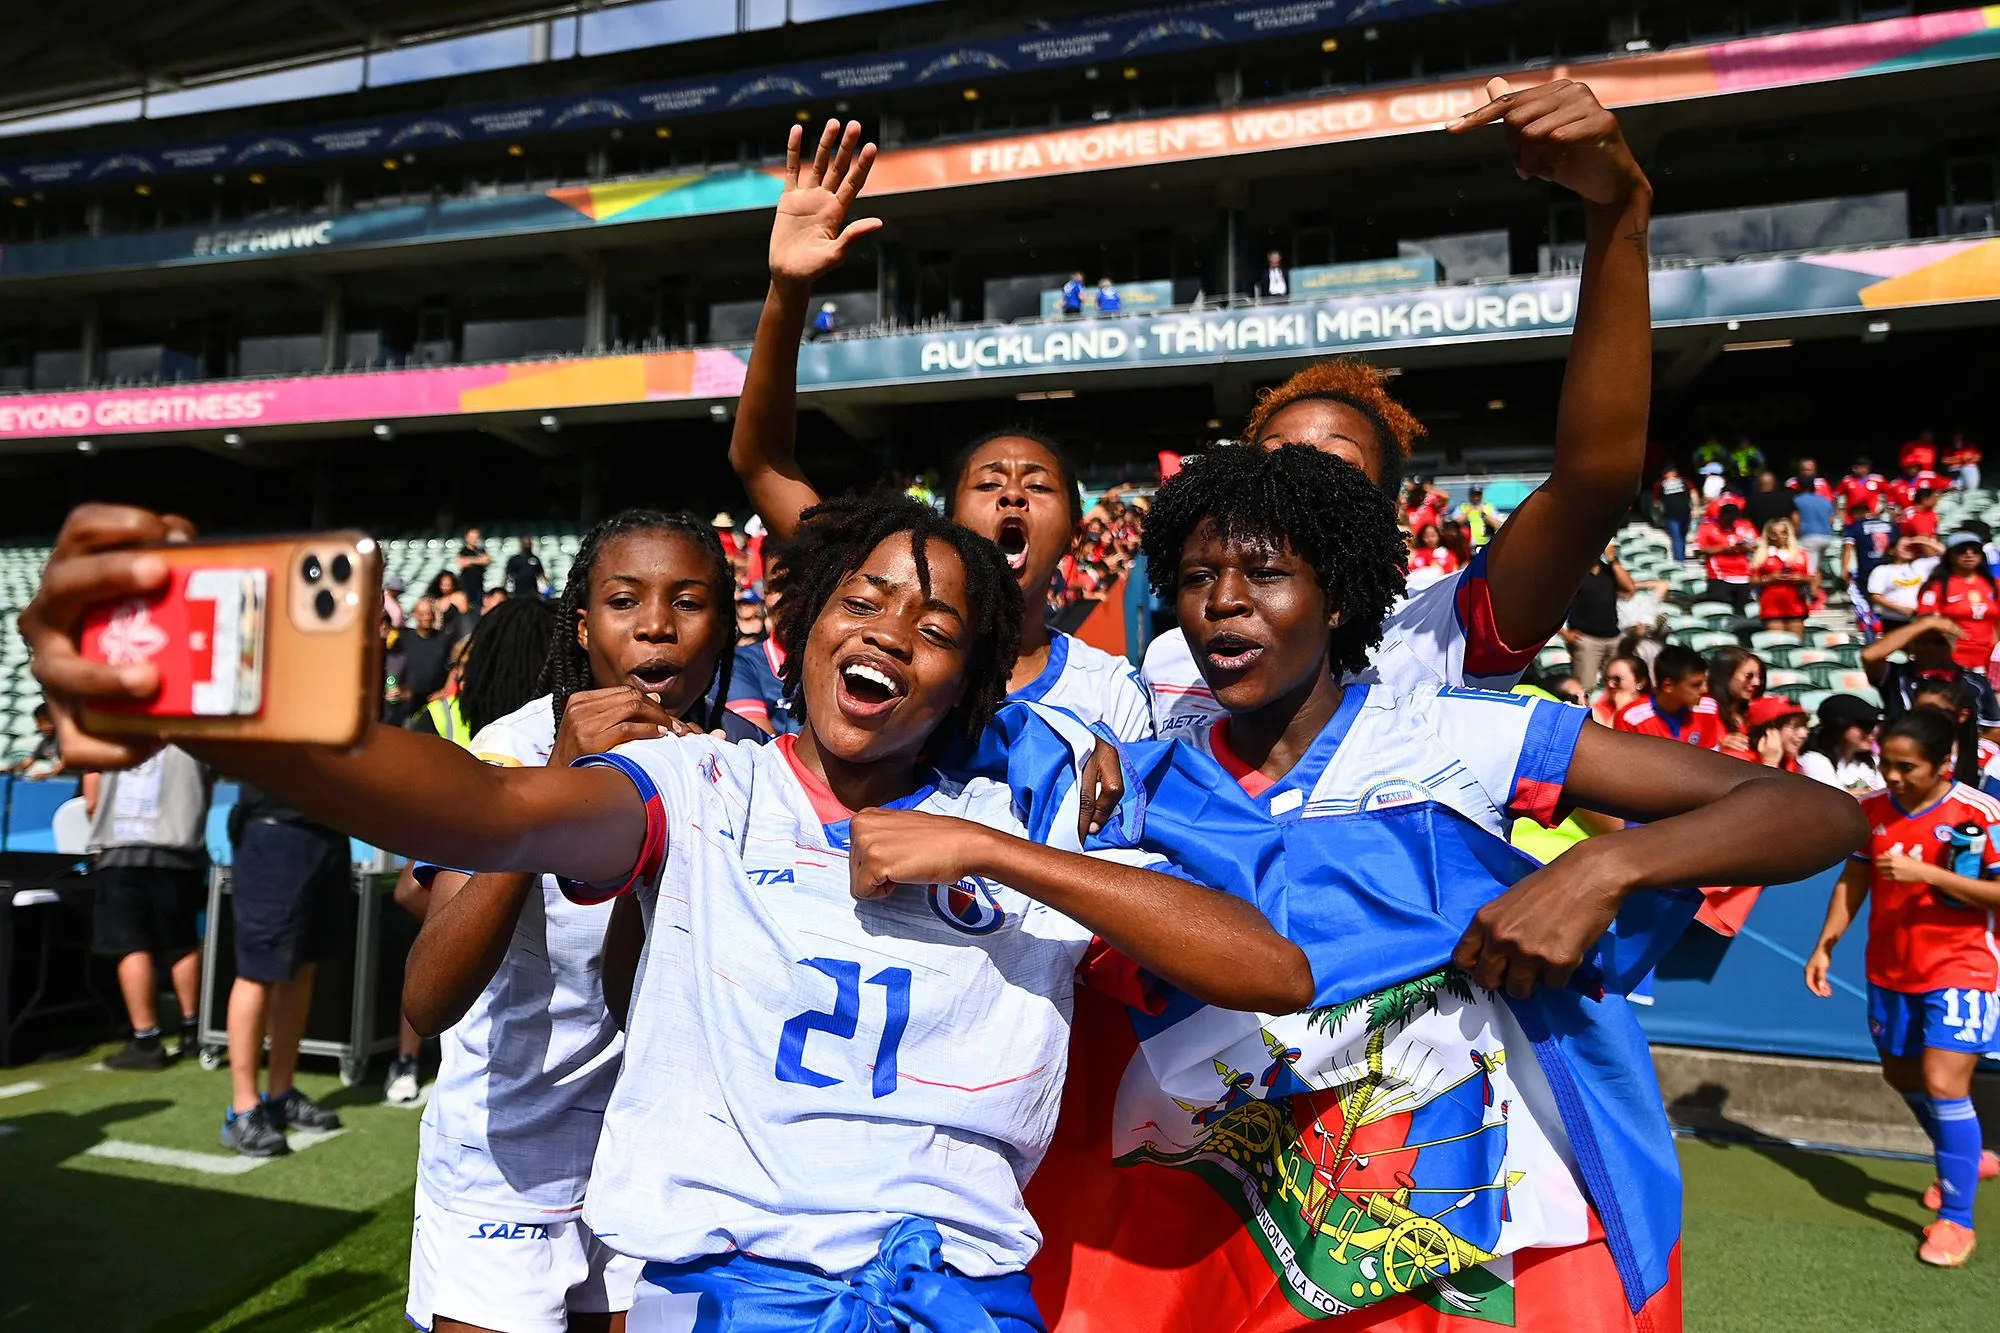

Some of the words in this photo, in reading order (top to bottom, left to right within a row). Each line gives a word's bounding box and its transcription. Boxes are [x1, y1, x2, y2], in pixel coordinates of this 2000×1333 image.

[1234, 8, 1273, 21] NORTH
[1276, 0, 1335, 16] HARBOUR
[1254, 12, 1317, 29] STADIUM
[1018, 40, 1056, 53] NORTH
[1058, 31, 1112, 48] HARBOUR
[1036, 44, 1094, 60] STADIUM
[970, 146, 1043, 175] FIFA
[1046, 119, 1224, 165] WOMEN'S
[1232, 100, 1373, 144] WORLD
[1389, 90, 1473, 123] CUP
[194, 220, 334, 258] #FIFAWWC
[921, 327, 1128, 371] AUCKLAND
[1151, 312, 1305, 355] TĀMAKI
[1316, 290, 1573, 343] MAKAURAU
[0, 402, 91, 431] EYOND
[1159, 714, 1209, 735] SAETA
[1942, 988, 1982, 1029] 11
[774, 956, 912, 1099] 21
[467, 1222, 549, 1240] SAETA
[1249, 1190, 1284, 1249] L'UNION
[1291, 1271, 1306, 1296] LA
